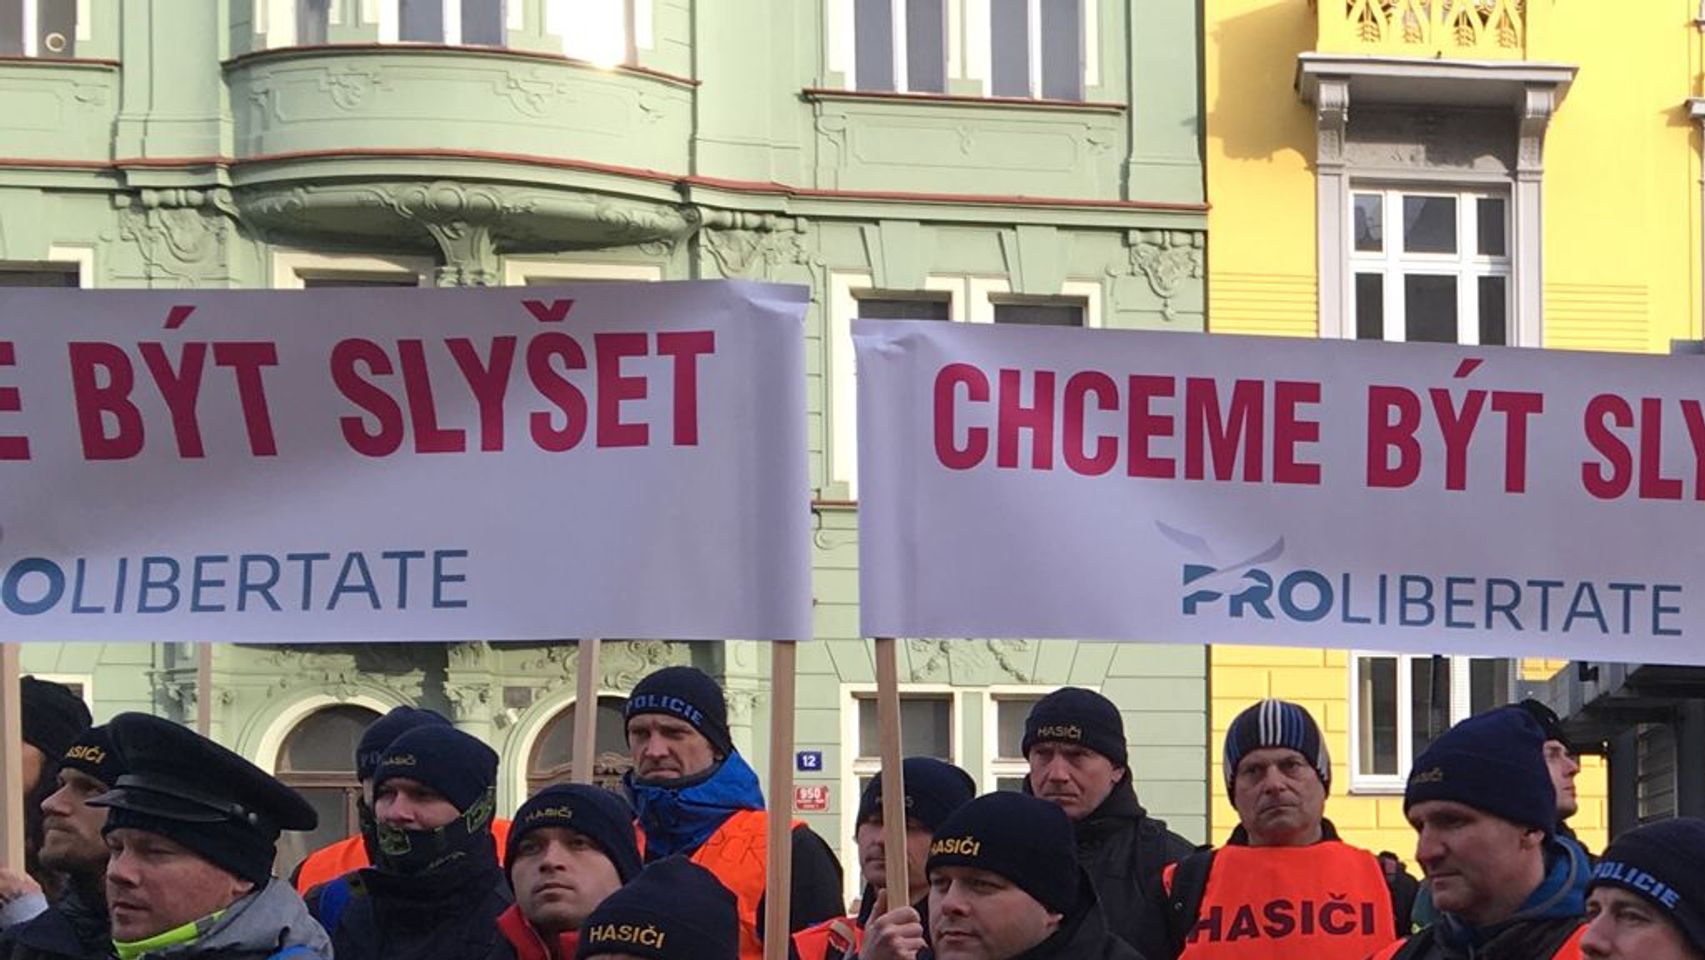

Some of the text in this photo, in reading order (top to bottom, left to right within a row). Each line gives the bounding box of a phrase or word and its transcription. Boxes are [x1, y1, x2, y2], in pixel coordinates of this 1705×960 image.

[67, 305, 278, 461] BÝT
[330, 299, 716, 458] SLYŠET
[933, 362, 1322, 485] CHCEME
[1367, 358, 1543, 493] BÝT
[1182, 563, 1684, 636] PROLIBERTATE
[802, 755, 817, 767] 12
[589, 922, 666, 949] HASIČI
[1186, 892, 1376, 944] HASIČI
